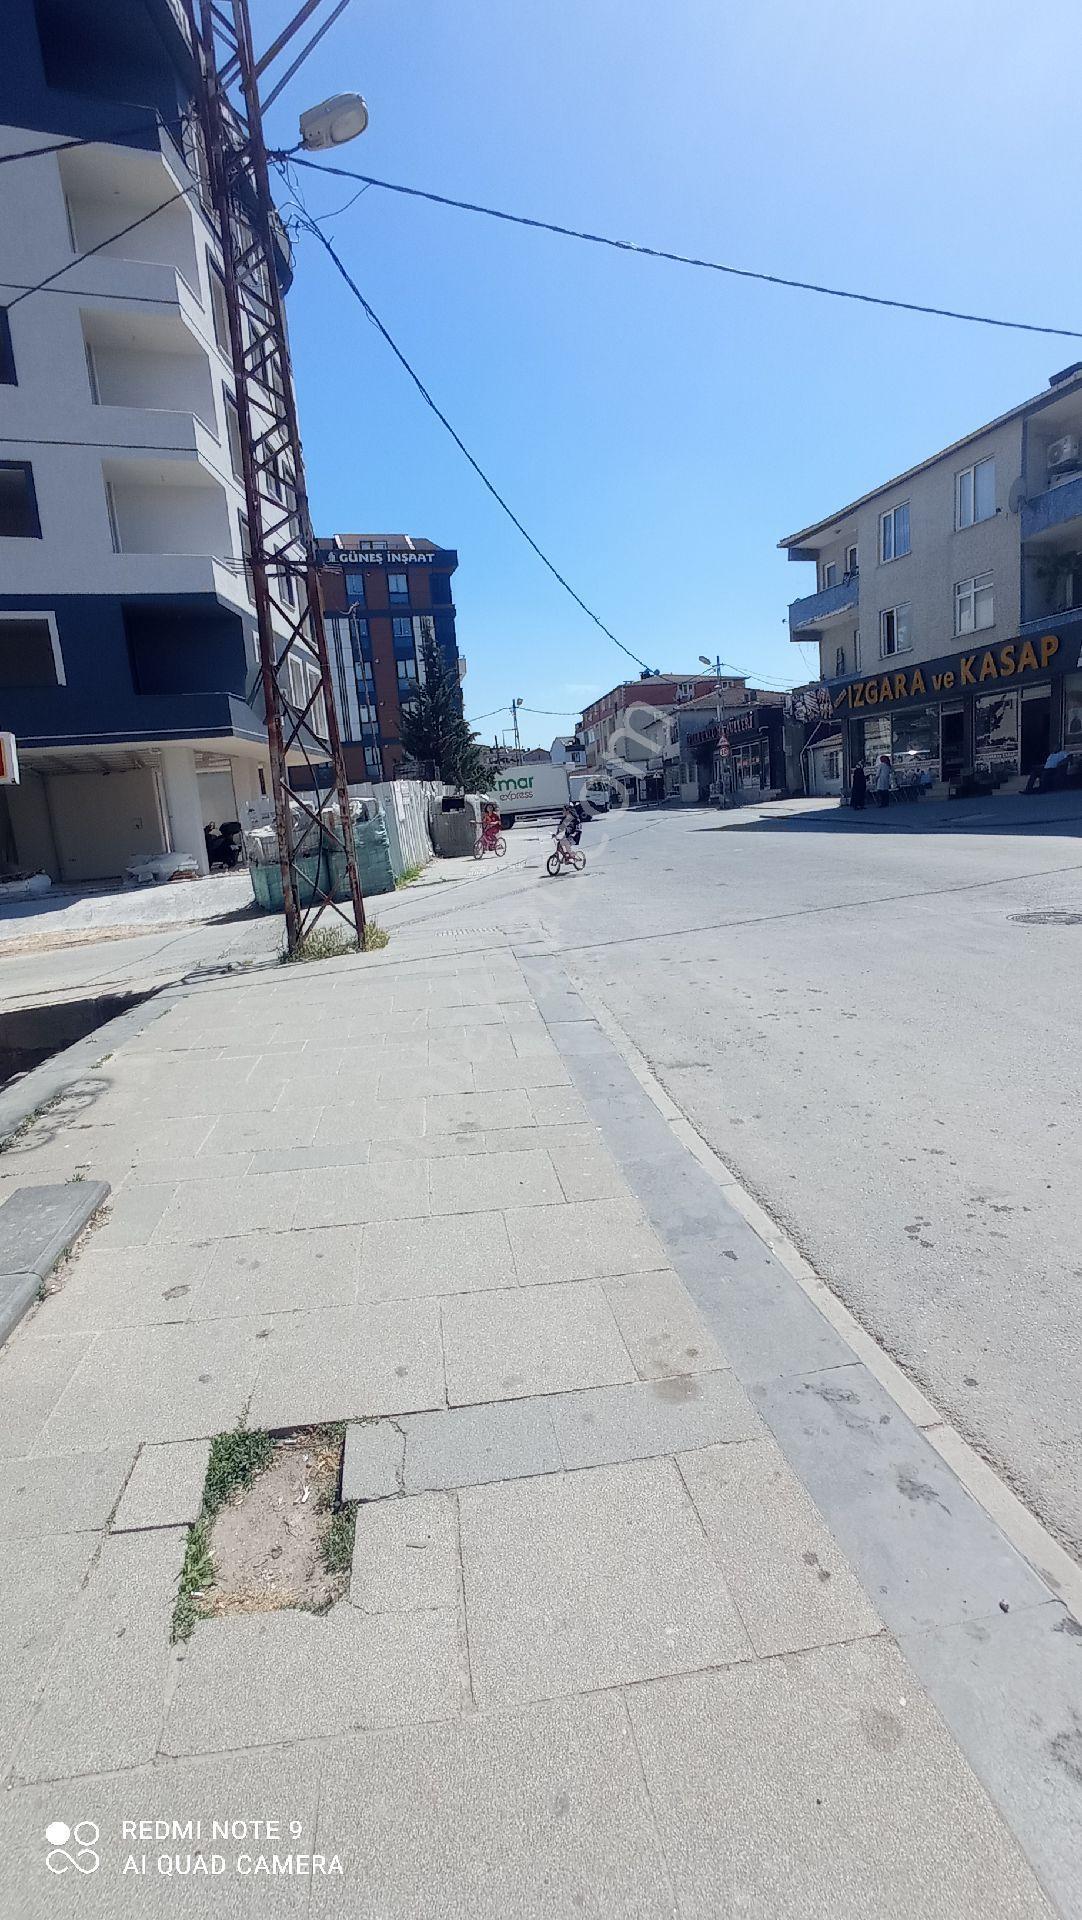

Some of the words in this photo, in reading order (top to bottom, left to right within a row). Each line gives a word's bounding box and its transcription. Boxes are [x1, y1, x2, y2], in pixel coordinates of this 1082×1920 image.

[339, 551, 383, 564] GÜNEŞ
[387, 551, 435, 564] İNŞAAT
[847, 668, 926, 709] IZGARA
[931, 671, 955, 691] ve
[960, 635, 1060, 686] KASAP
[499, 791, 534, 802] express
